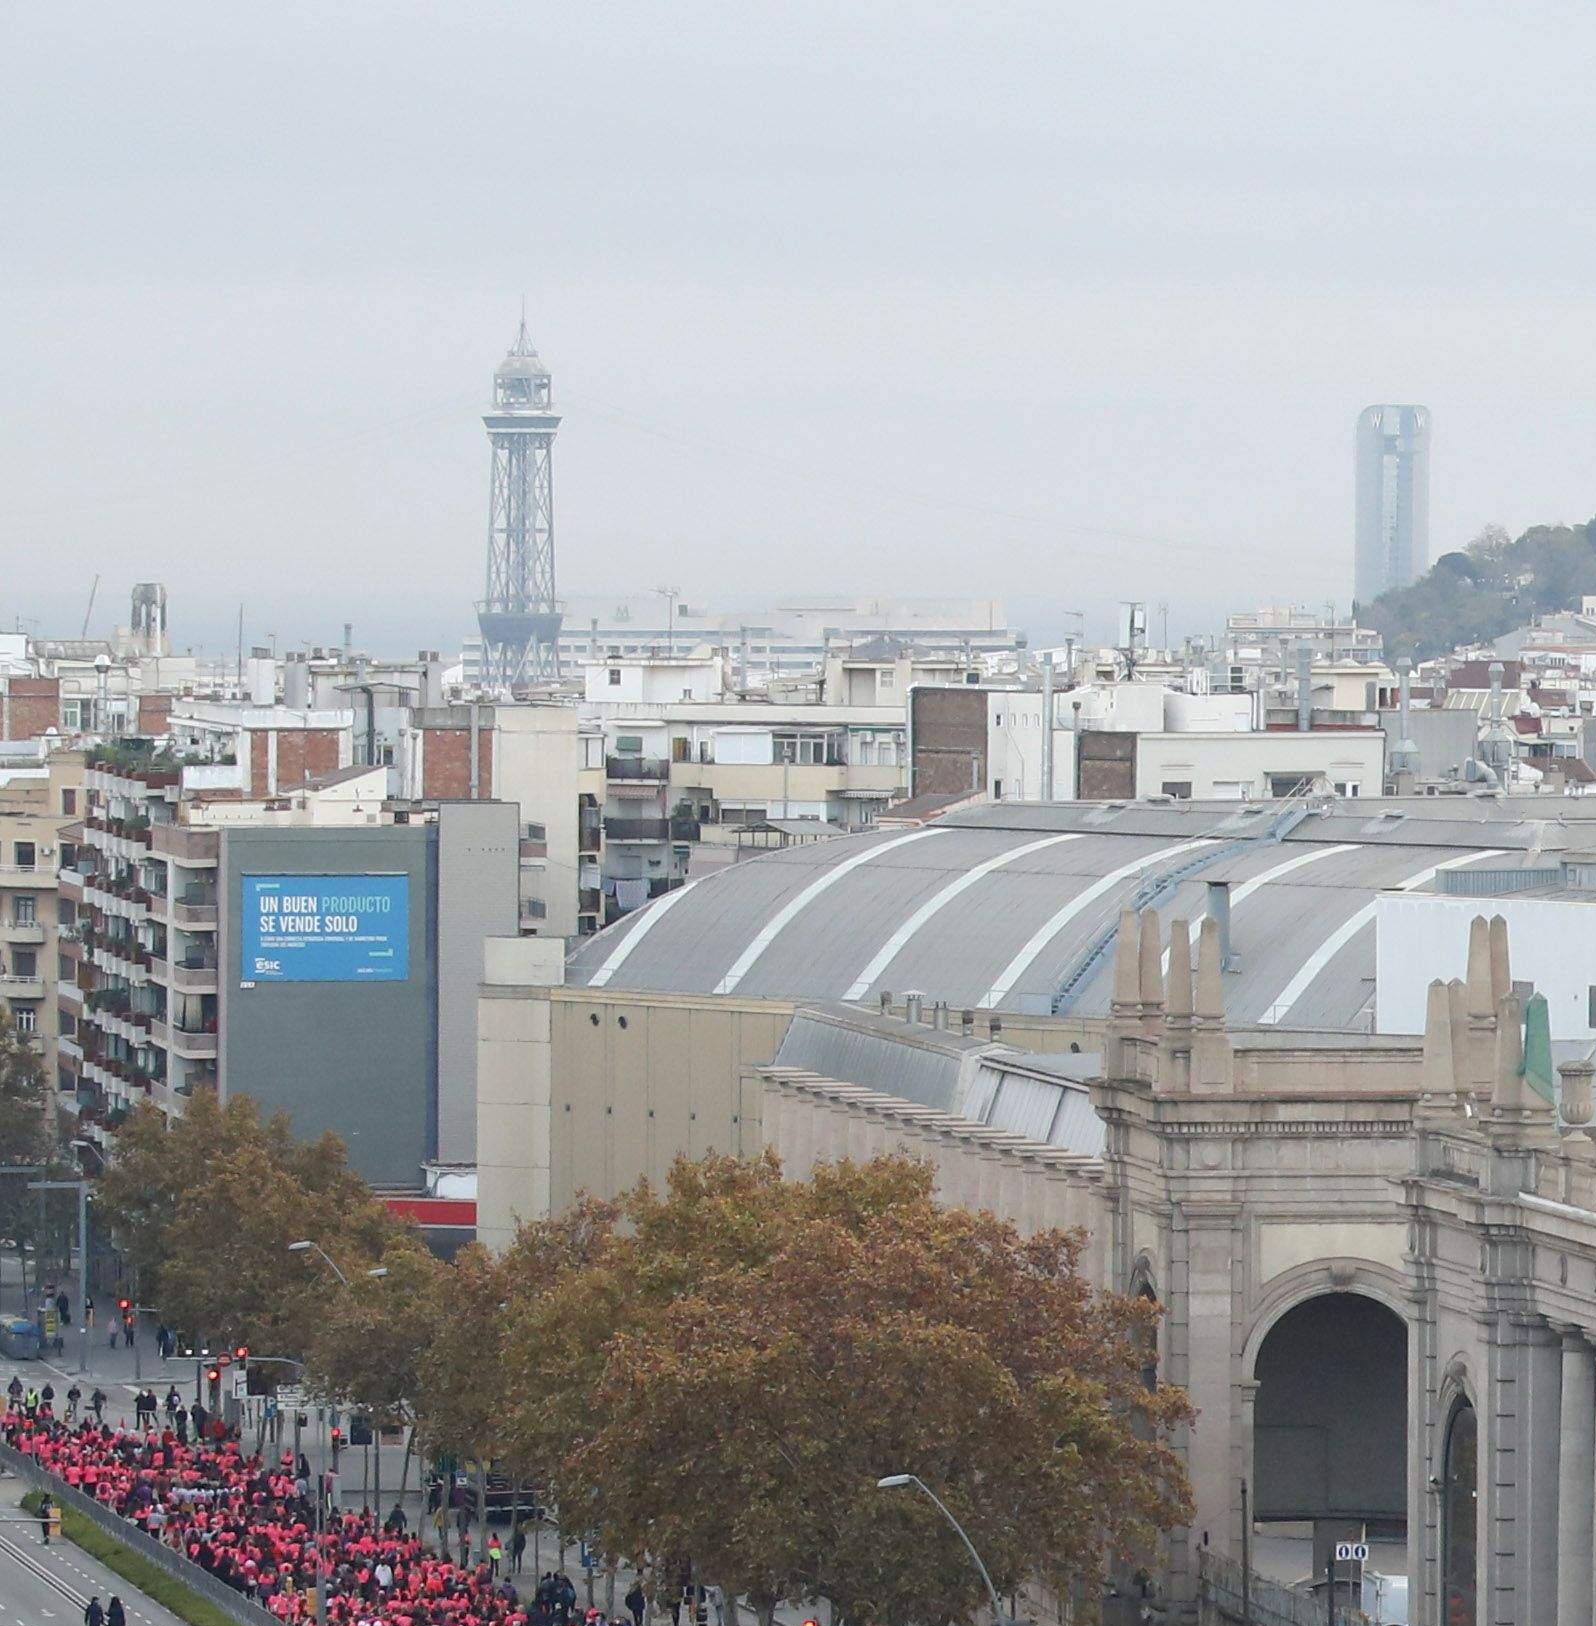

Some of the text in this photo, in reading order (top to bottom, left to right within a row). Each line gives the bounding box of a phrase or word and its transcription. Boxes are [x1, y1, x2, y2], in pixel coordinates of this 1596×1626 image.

[260, 896, 391, 912] UN BUEN PRODUCTO
[260, 916, 358, 932] SE VENDE SOLO
